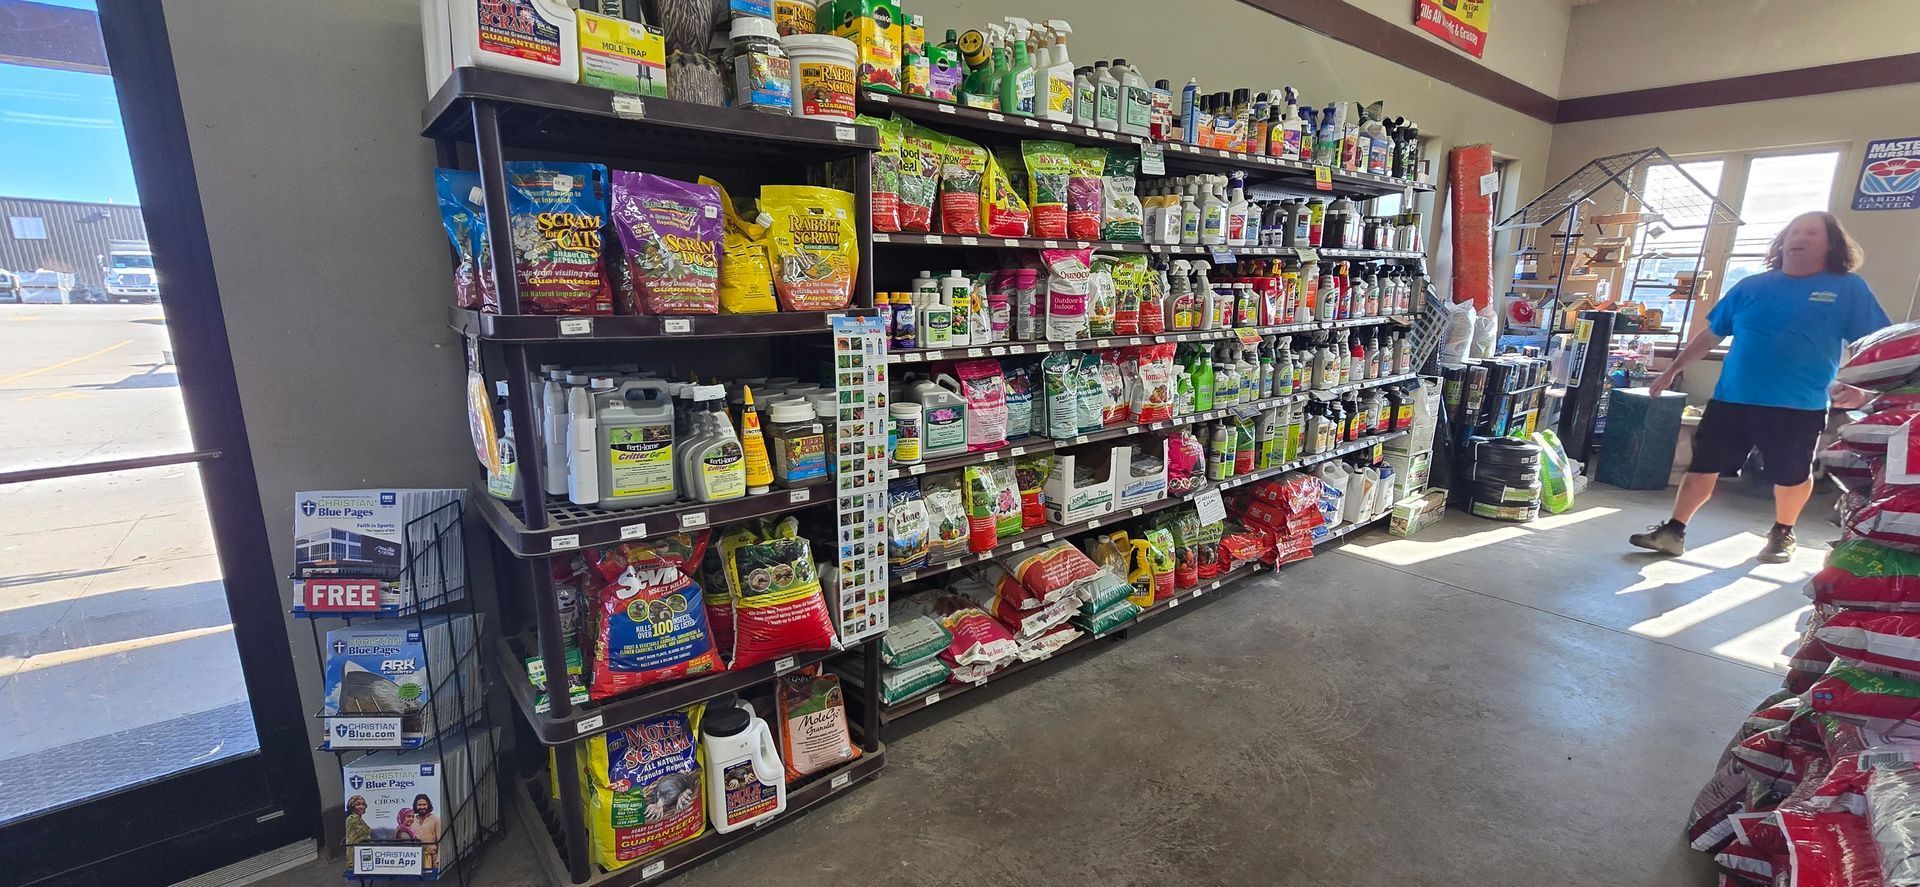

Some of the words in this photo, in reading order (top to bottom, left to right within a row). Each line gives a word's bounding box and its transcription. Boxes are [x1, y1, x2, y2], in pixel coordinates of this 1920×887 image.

[480, 11, 535, 35] SCRAM
[1432, 9, 1441, 24] All
[1455, 24, 1459, 36] &
[490, 26, 510, 35] Natural
[511, 31, 533, 40] Granular
[481, 32, 551, 53] GUARANTEED!
[602, 42, 624, 54] MOLE
[626, 47, 647, 58] TRAP
[1859, 195, 1915, 203] GARDEN
[536, 213, 600, 231] SCRAM
[788, 214, 841, 233] RABBIT
[545, 230, 557, 239] for
[557, 229, 600, 251] CATS
[793, 231, 840, 245] SCRAM
[665, 233, 716, 254] SCRAM
[553, 250, 590, 258] GRANULAR
[517, 269, 533, 277] Cats
[534, 269, 552, 277] from
[555, 269, 583, 278] visiting
[528, 278, 600, 286] Guaranteed!
[660, 280, 672, 288] Dog
[801, 436, 823, 447] DEER
[618, 452, 650, 461] Critter
[707, 464, 728, 472] Critter
[317, 499, 374, 507] CHRISTIAN
[318, 508, 342, 516] Blue
[344, 508, 374, 519] Pages
[312, 585, 376, 606] FREE
[636, 624, 652, 633] KILLS
[652, 619, 673, 637] 100
[348, 638, 401, 646] CHRISTIAN
[638, 631, 652, 640] OVER
[349, 646, 371, 655] Blue
[373, 646, 400, 656] Pages
[380, 657, 416, 671] ARK
[349, 730, 395, 738] Blue.com
[625, 719, 682, 747] MOLE
[805, 721, 836, 736] Granules
[624, 734, 691, 769] SCRAM
[643, 763, 657, 773] ALL
[657, 754, 684, 769] NATURAL
[636, 768, 665, 783] Granular
[365, 780, 387, 788] Blue
[389, 780, 415, 789] Pages
[621, 815, 695, 848] GUARANTEED
[399, 858, 416, 867] App
